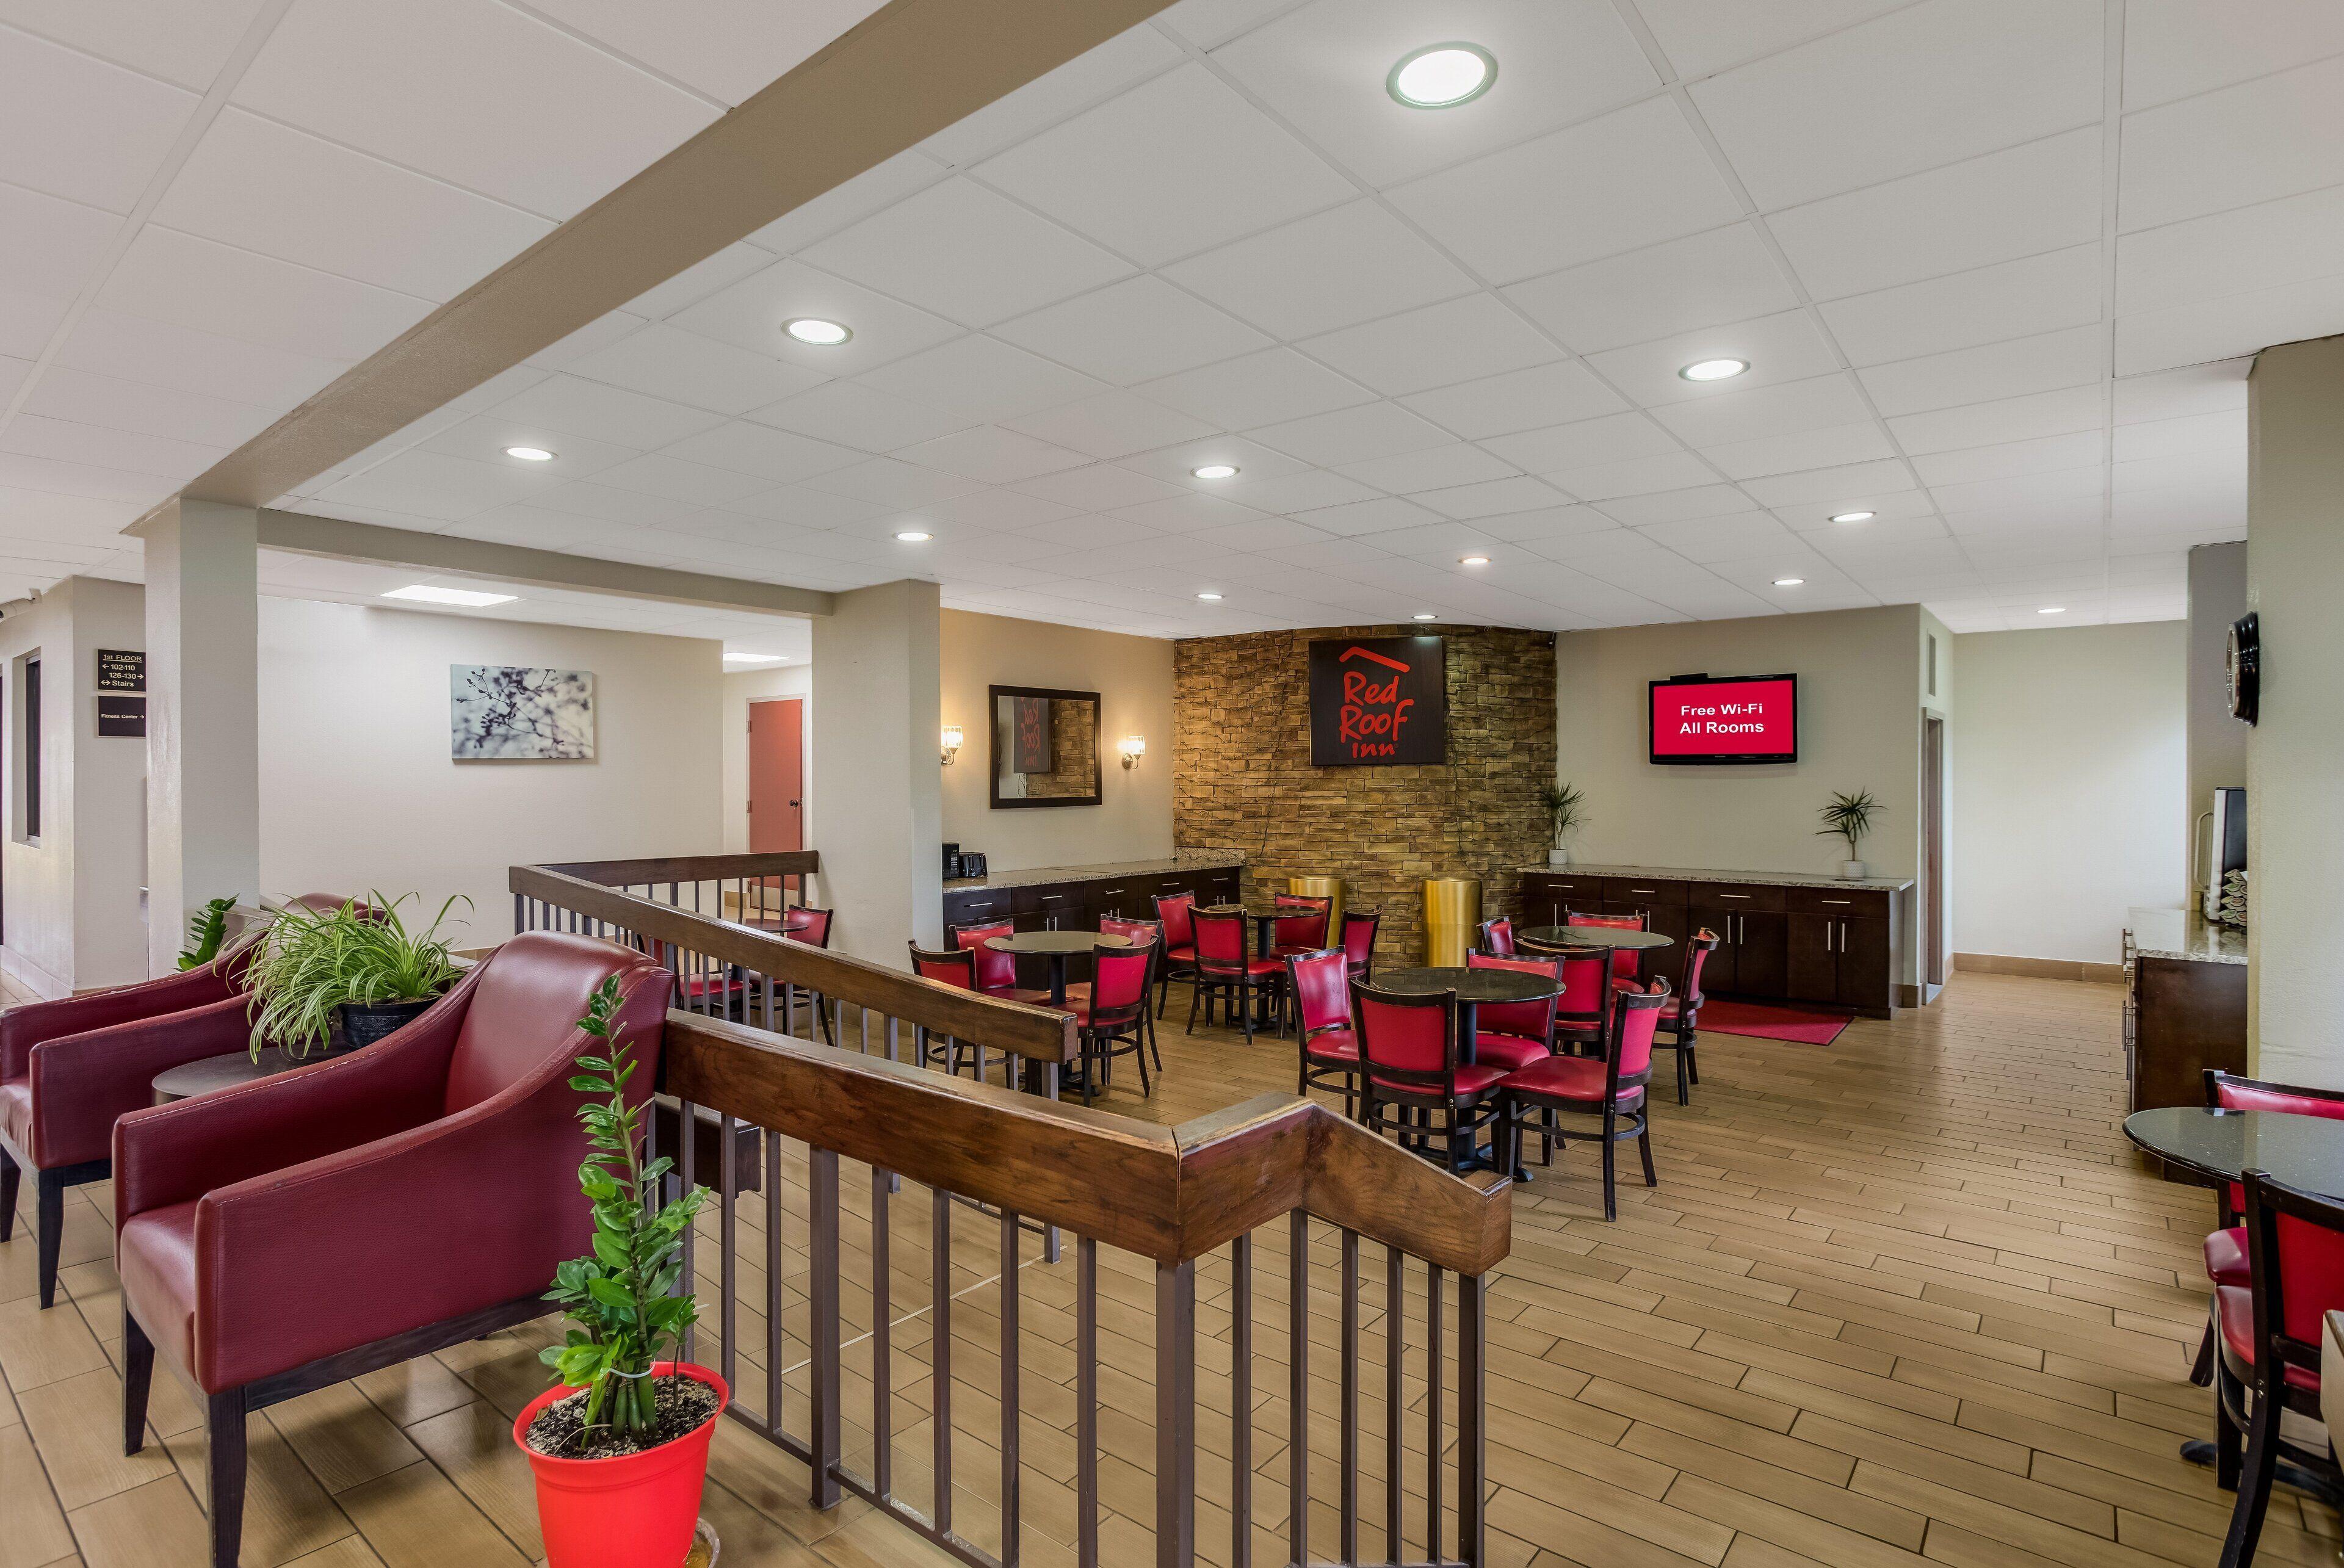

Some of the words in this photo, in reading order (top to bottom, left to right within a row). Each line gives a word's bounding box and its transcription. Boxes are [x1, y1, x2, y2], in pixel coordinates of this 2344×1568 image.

[1344, 671, 1400, 706] Red
[1339, 698, 1414, 743] Roof
[1681, 706, 1716, 716] Free
[1720, 703, 1763, 715] Wi-Fi
[1679, 722, 1701, 734] All
[1706, 721, 1764, 734] Rooms
